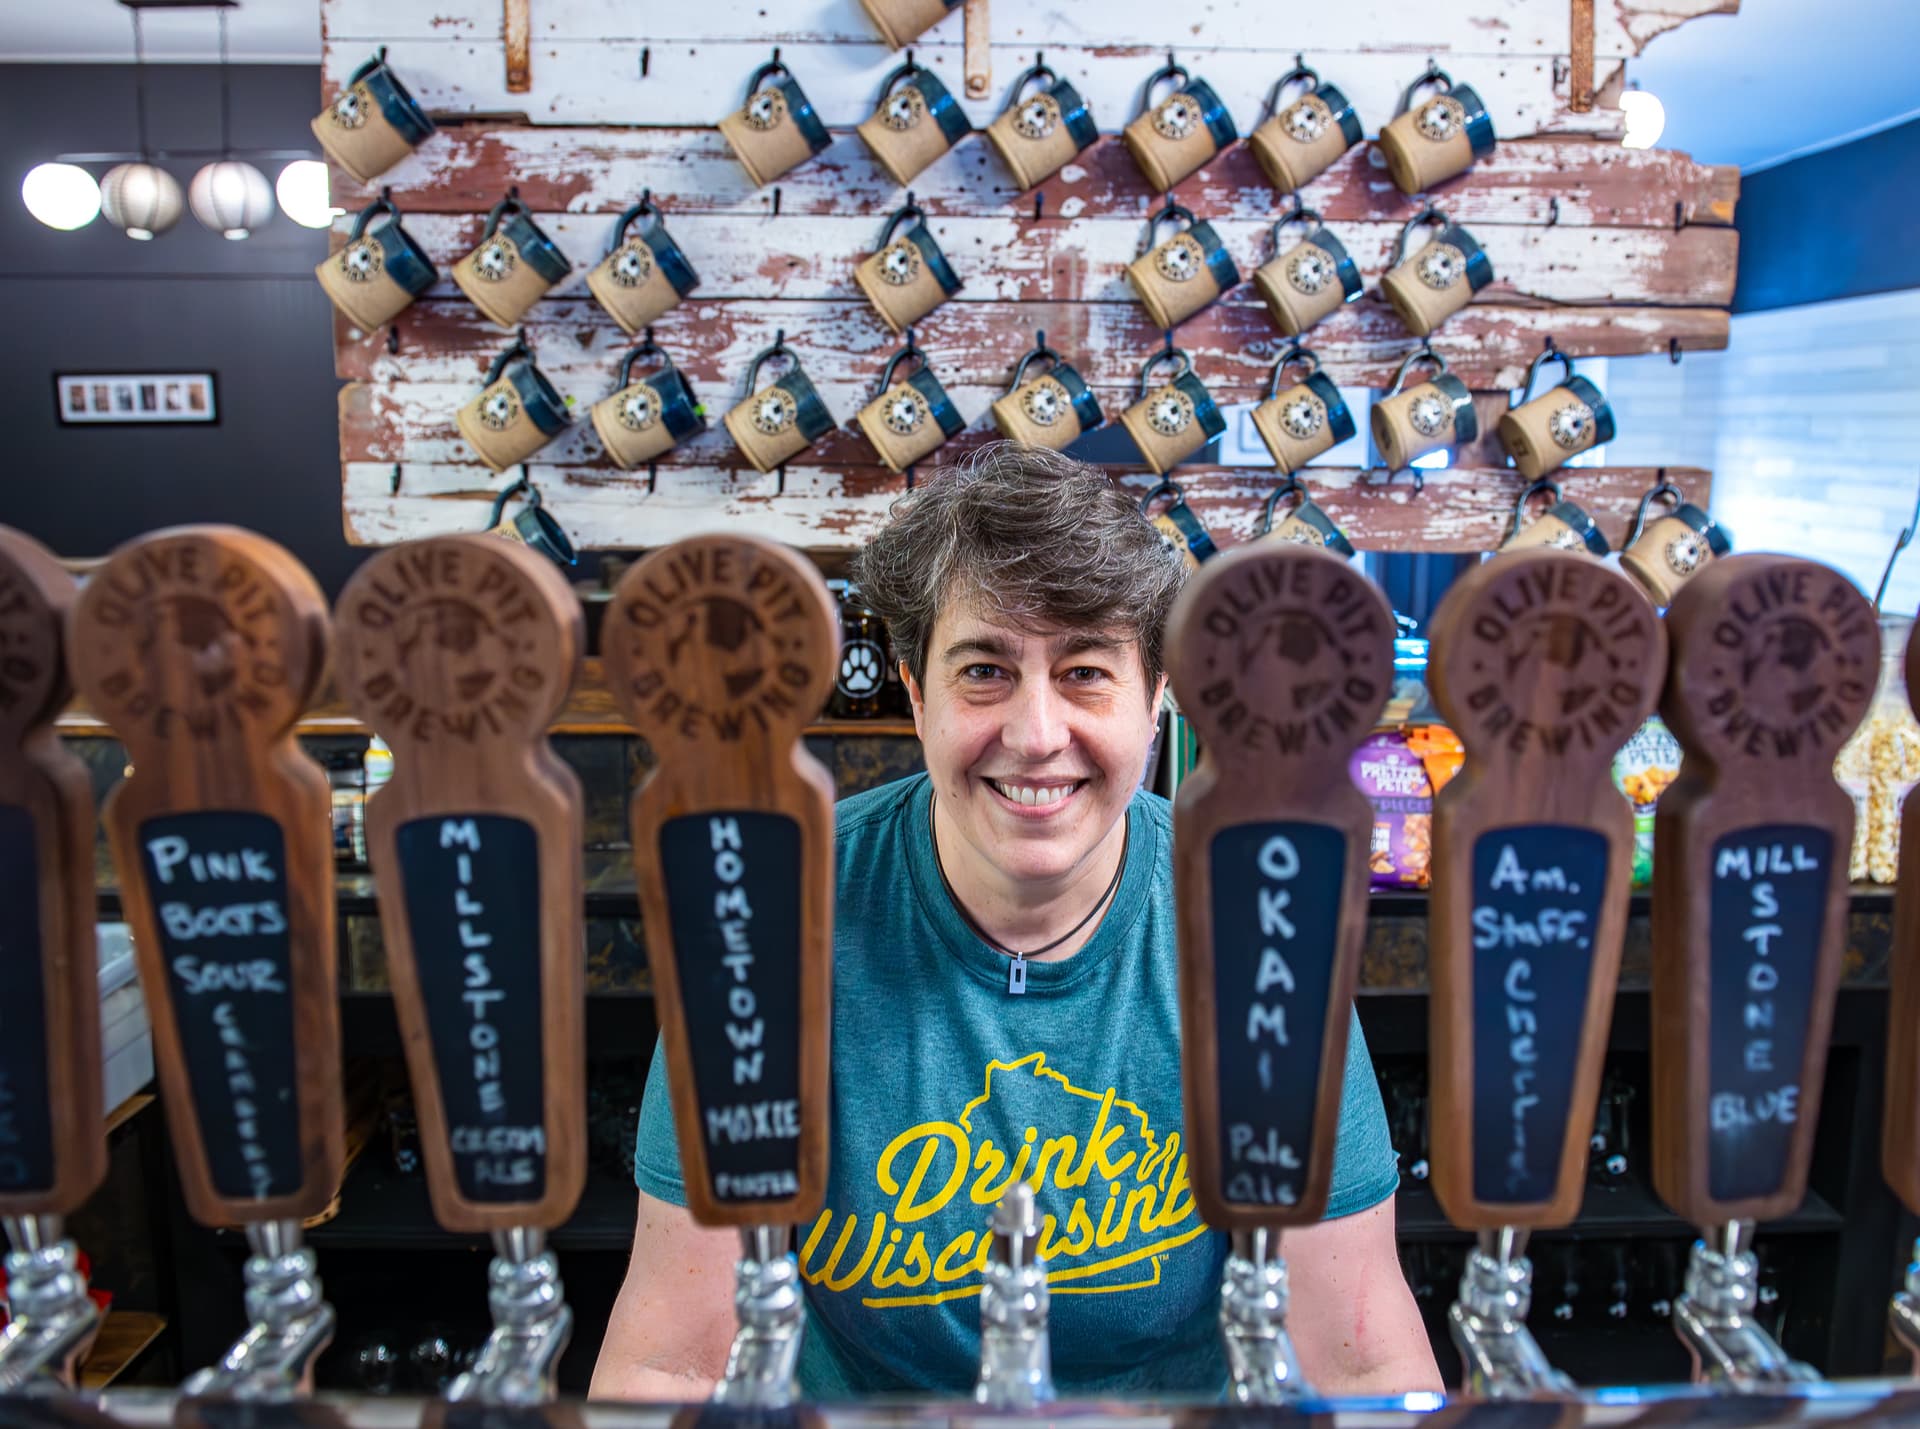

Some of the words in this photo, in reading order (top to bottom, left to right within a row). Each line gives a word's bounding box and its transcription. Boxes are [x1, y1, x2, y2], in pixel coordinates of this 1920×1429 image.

[358, 551, 460, 627] OLIVE
[476, 564, 537, 624] PIT
[625, 550, 734, 628] OLIVE
[746, 564, 804, 622] PIT
[1205, 560, 1311, 638] OLIVE
[1324, 577, 1376, 636] PIT
[1474, 565, 1579, 643] OLIVE
[1590, 583, 1644, 641] PIT
[1713, 569, 1810, 648] OLIVE
[1821, 584, 1869, 641] PIT
[1629, 749, 1677, 765] PETE
[1489, 844, 1581, 894] Am.
[439, 818, 505, 1112] MILLSTONE
[709, 817, 765, 1085] HOMETOWN
[1247, 834, 1301, 1092] OKAMI
[705, 1100, 801, 1146] MOXIE
[1229, 1123, 1301, 1168] Pale
[1711, 1085, 1800, 1131] BLUE
[877, 1087, 1137, 1223] Drink
